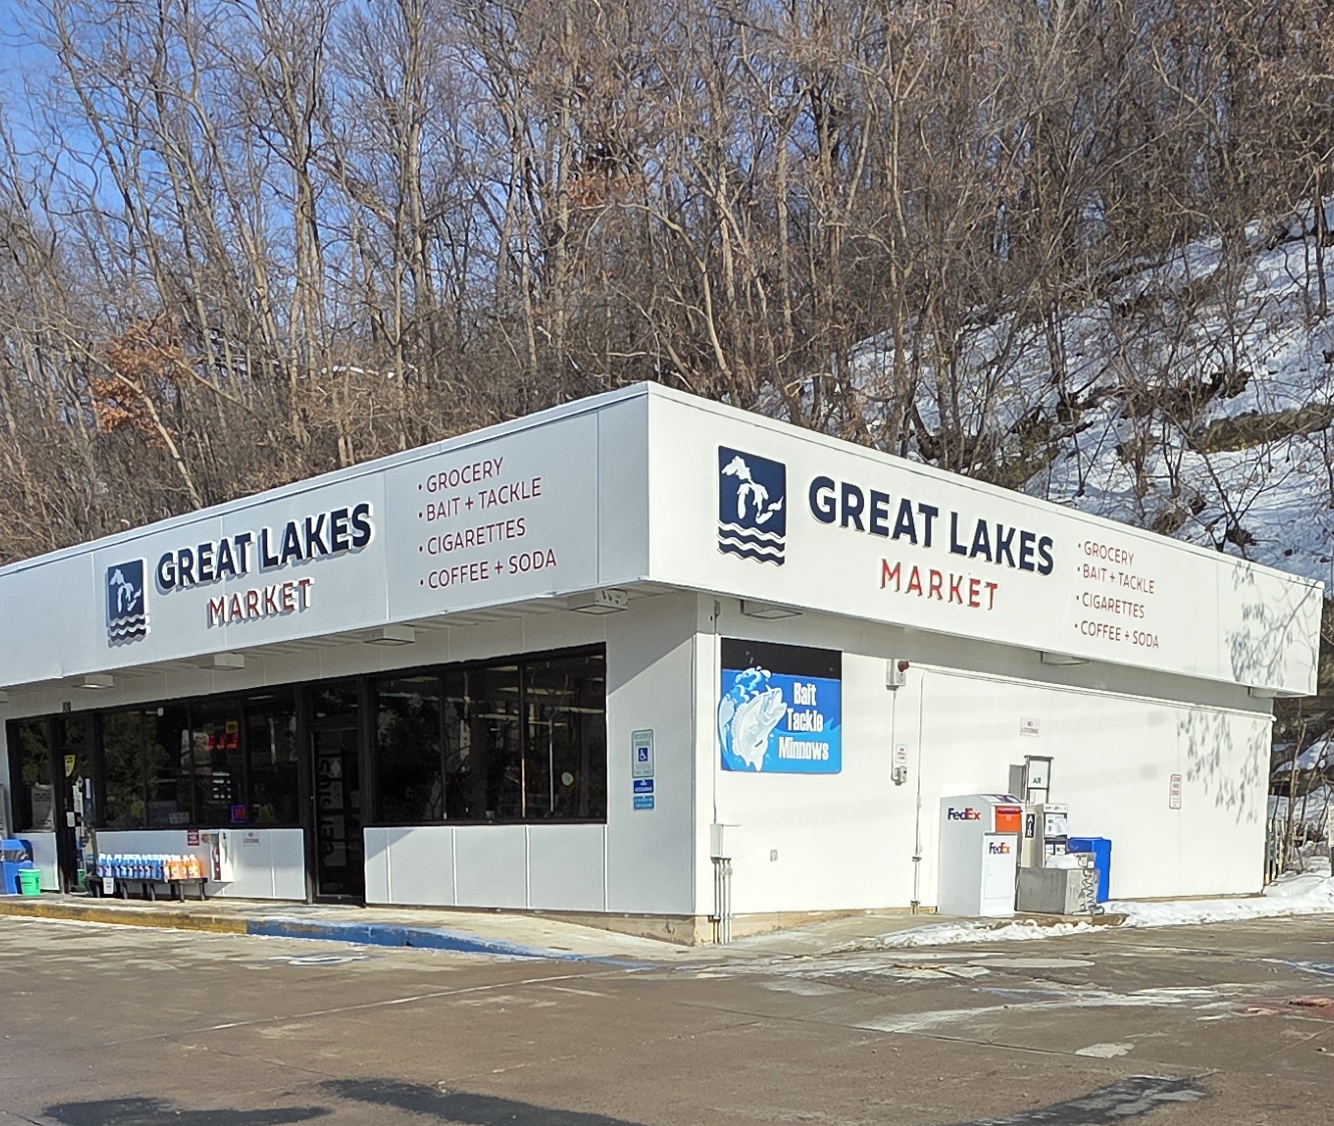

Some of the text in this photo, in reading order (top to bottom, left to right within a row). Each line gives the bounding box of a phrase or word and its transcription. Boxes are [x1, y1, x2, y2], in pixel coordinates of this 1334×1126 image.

[426, 459, 503, 493] GROCERY
[427, 497, 460, 521] BAIT
[478, 477, 541, 509] TACKLE
[427, 518, 526, 555] CIGARETTES
[809, 476, 1054, 575] GREAT LAKES
[157, 503, 372, 590] GREAT LAKES
[1084, 541, 1134, 566] GROCERY
[428, 561, 489, 589] COFFEE
[509, 549, 557, 574] SODA
[1083, 563, 1107, 582] BAIT
[1118, 572, 1155, 594] TACKLE
[880, 558, 998, 610] MARKET
[207, 579, 313, 626] MARKET
[1082, 592, 1145, 619] CIGARETTES
[1081, 620, 1121, 641] COFFEE
[1133, 630, 1159, 648] SODA
[793, 682, 817, 706] Bait
[787, 708, 824, 732] Tackle
[778, 736, 830, 761] Minnows
[1032, 777, 1041, 785] AIR
[947, 807, 981, 821] FedEx
[989, 842, 1011, 855] FedEx
